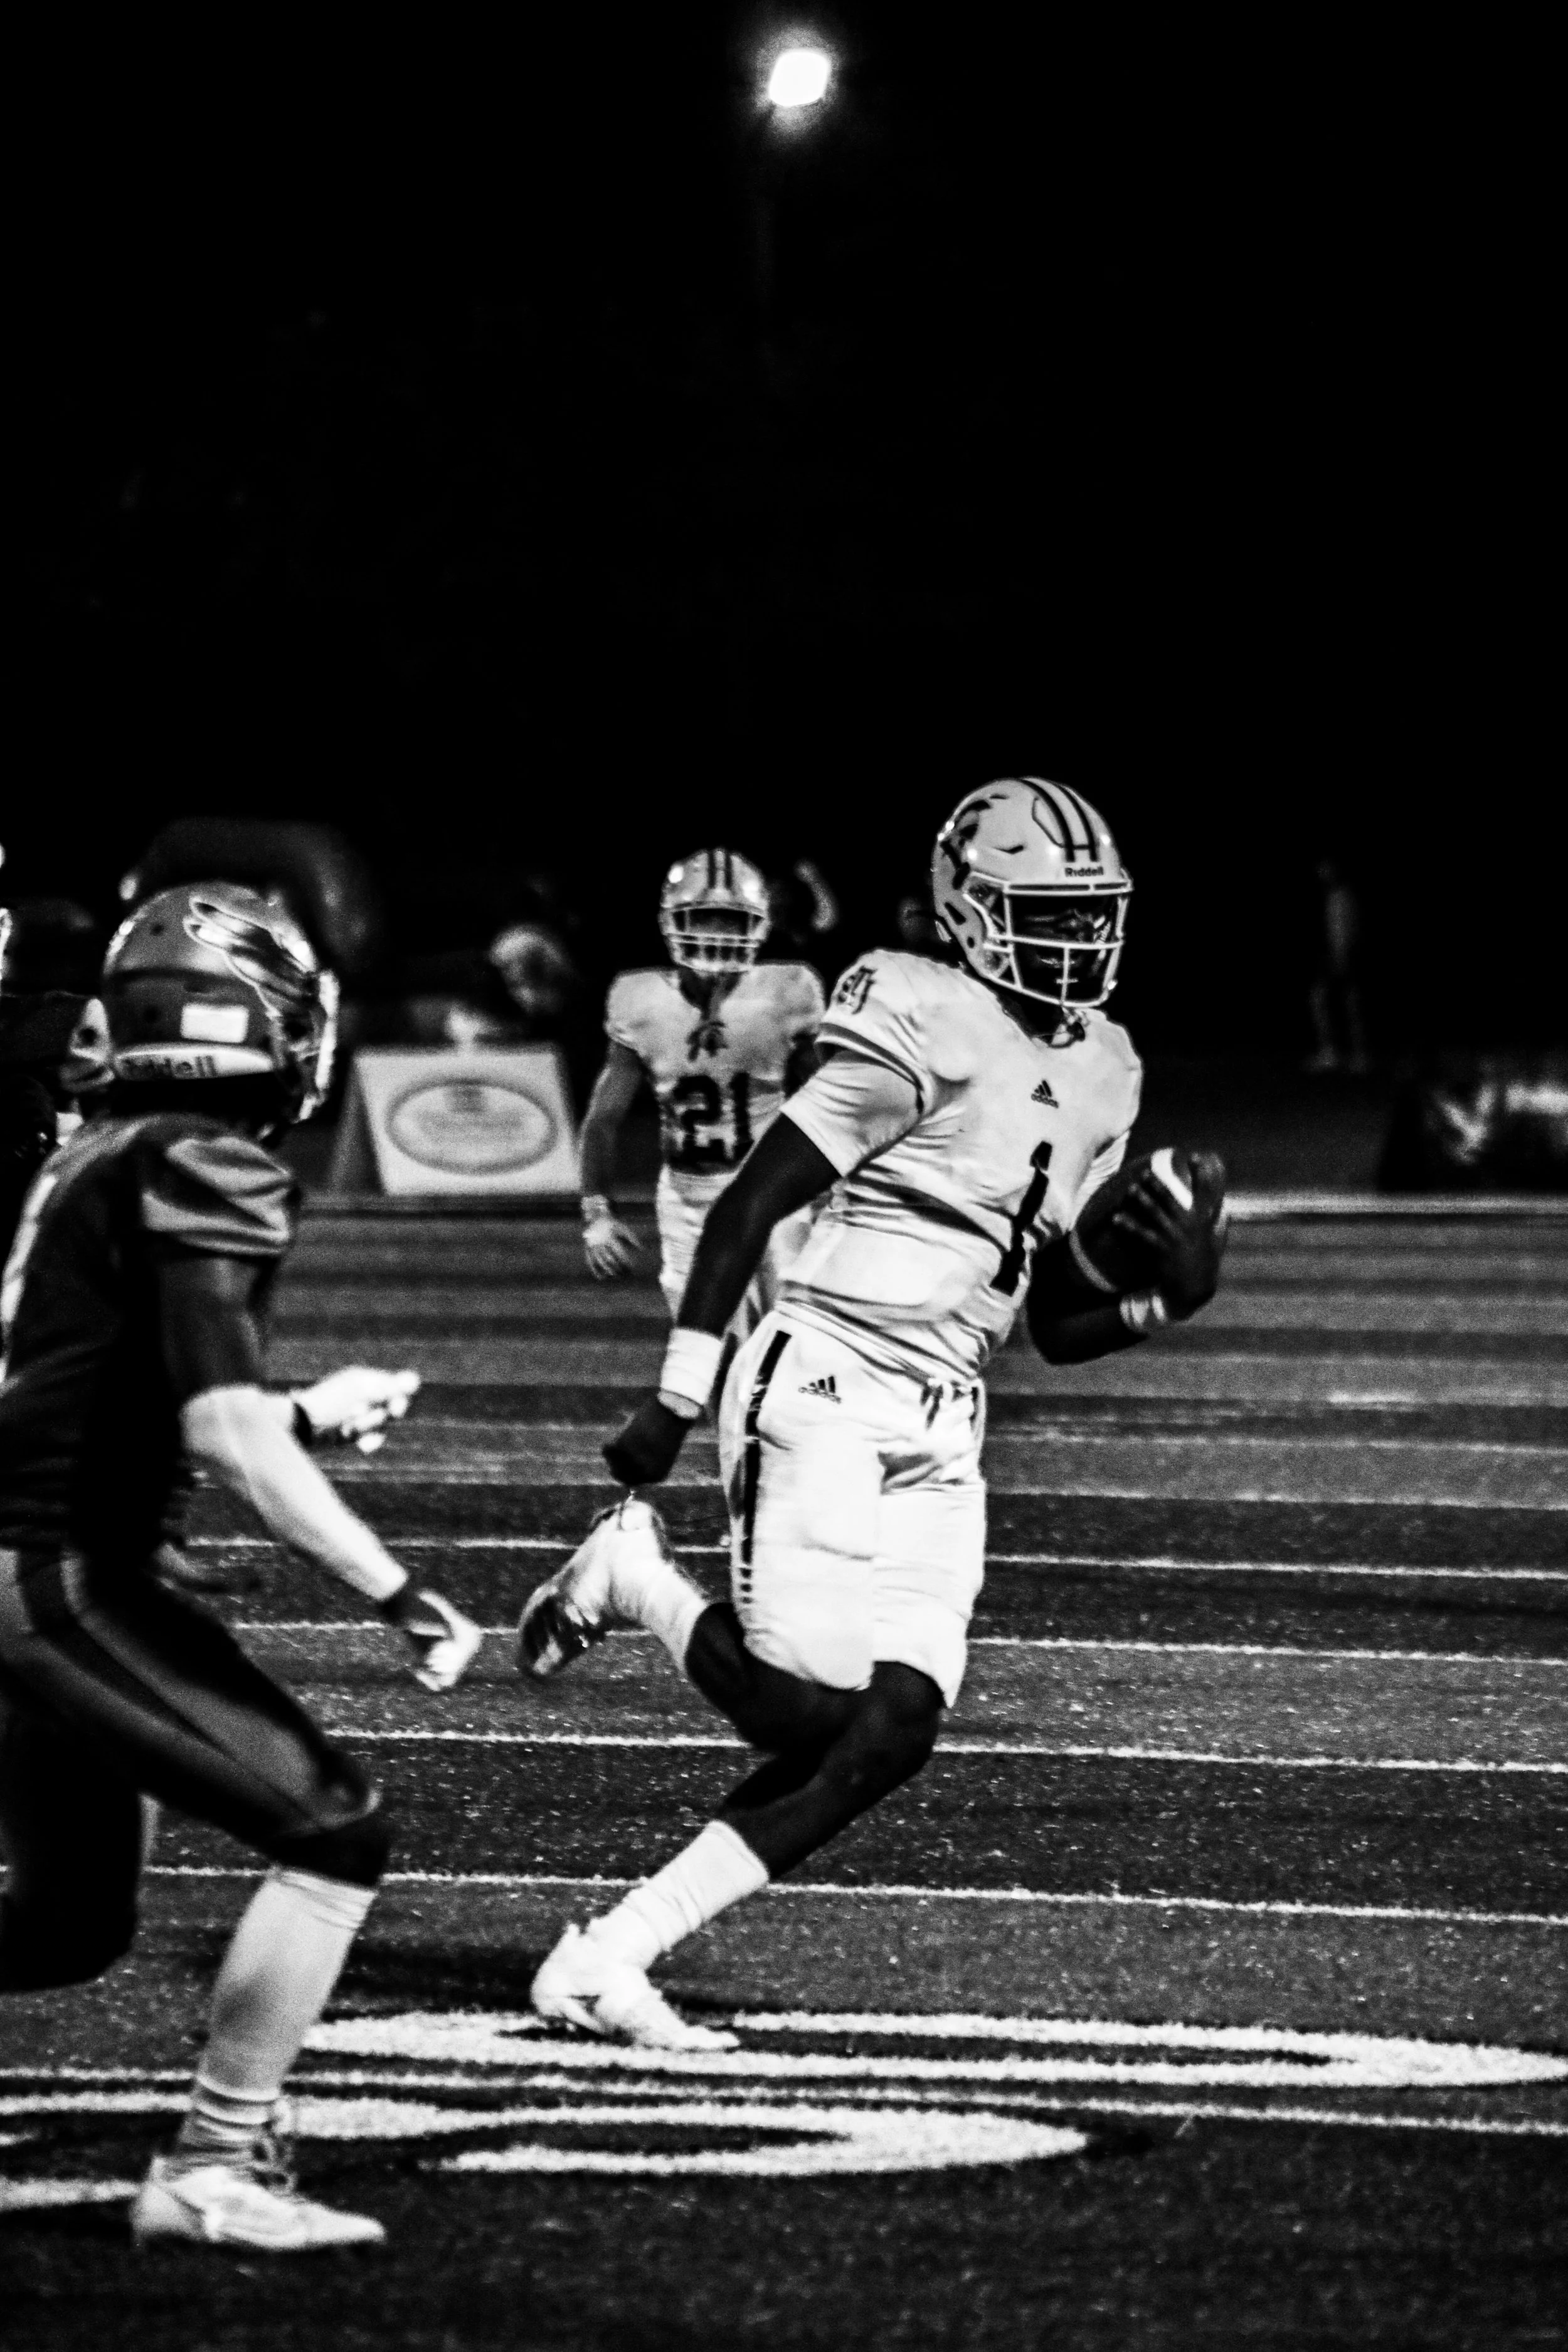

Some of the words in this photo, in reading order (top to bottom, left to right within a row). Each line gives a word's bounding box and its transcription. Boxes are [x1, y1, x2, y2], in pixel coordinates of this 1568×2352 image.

[1064, 866, 1104, 877] Riddell
[670, 1072, 754, 1163] 21
[989, 1140, 1052, 1297] 1
